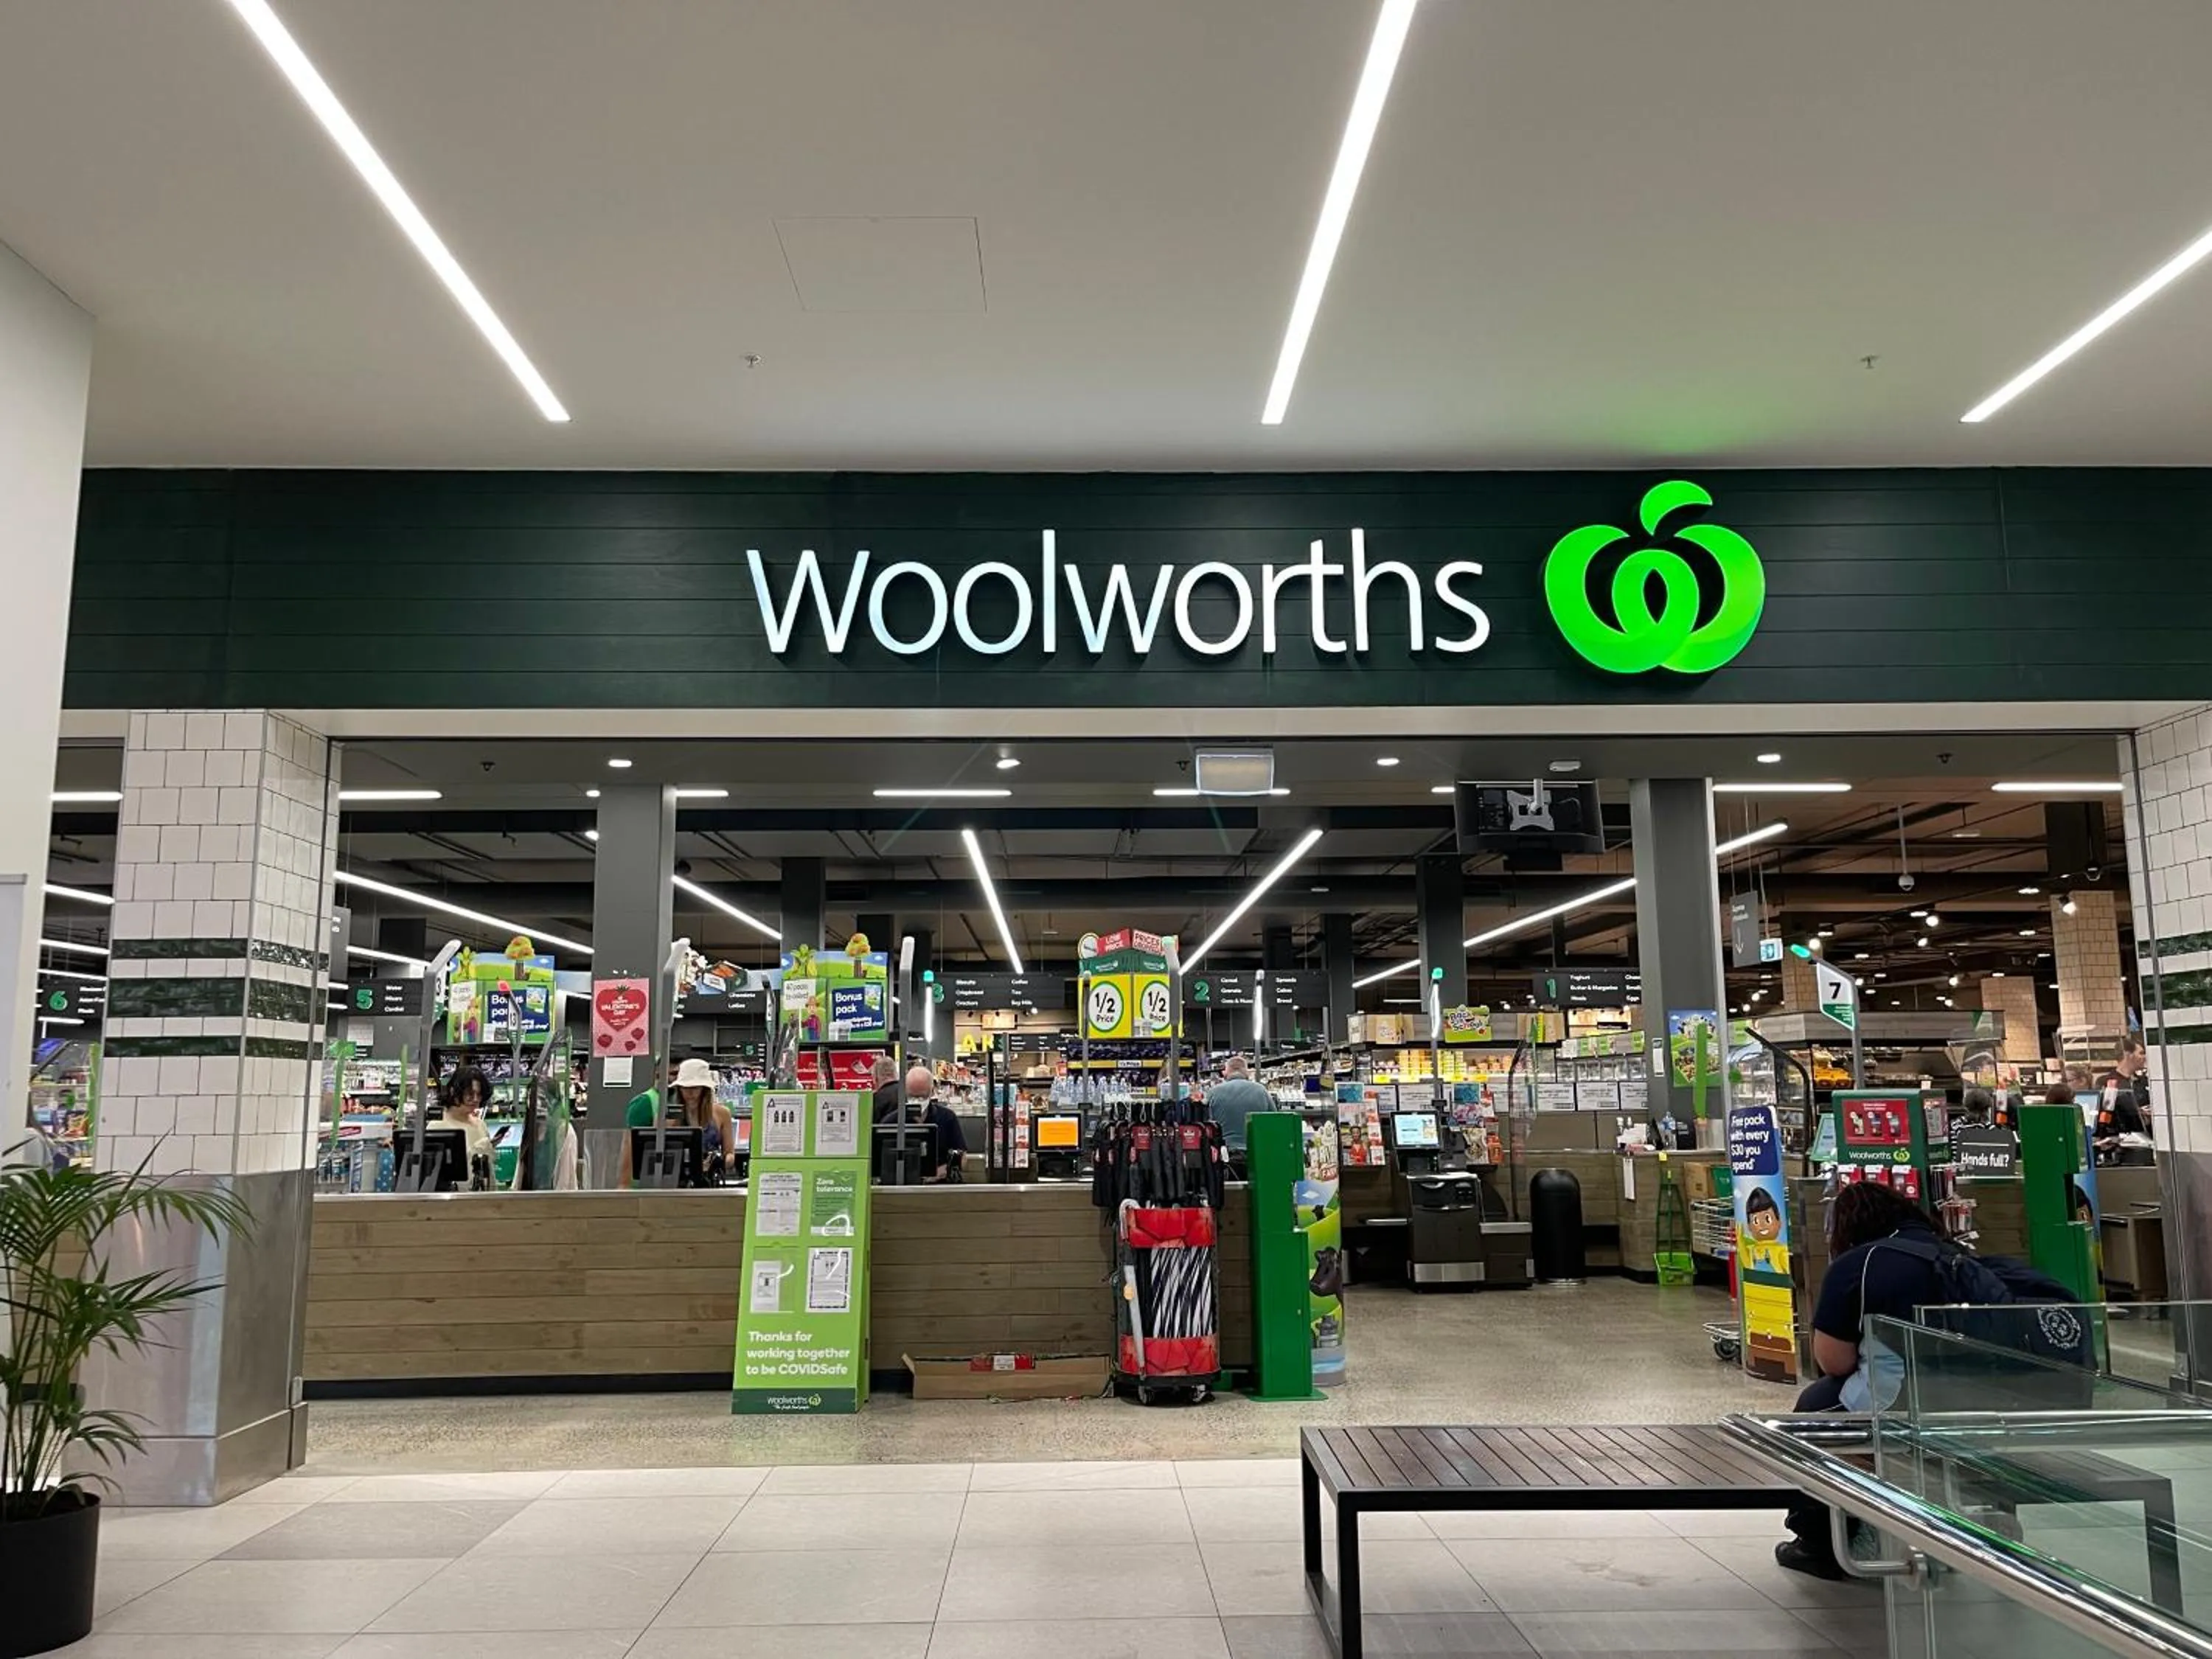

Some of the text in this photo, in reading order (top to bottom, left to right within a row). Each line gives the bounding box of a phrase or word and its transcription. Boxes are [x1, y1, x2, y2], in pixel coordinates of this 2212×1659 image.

[746, 528, 1489, 655] Woolworths
[1194, 981, 1210, 1001] 2
[1546, 978, 1557, 998] 1
[1829, 982, 1841, 999] 7
[49, 990, 68, 1010] 6
[356, 989, 373, 1009] 5
[835, 992, 863, 1003] Bonus
[601, 1003, 640, 1011] VALENTINE'S
[835, 1004, 858, 1016] pack
[1096, 1014, 1114, 1023] Price
[1150, 1014, 1166, 1023] Price
[1744, 1114, 1766, 1128] pack
[1731, 1130, 1770, 1144] with every
[1731, 1144, 1761, 1158] $30 you
[1848, 1150, 1892, 1161] Woolworths
[1961, 1152, 2010, 1167] Hands full?
[748, 1331, 813, 1343] Thanks for
[746, 1346, 850, 1362] working together
[745, 1363, 849, 1375] to be COVIDSafe
